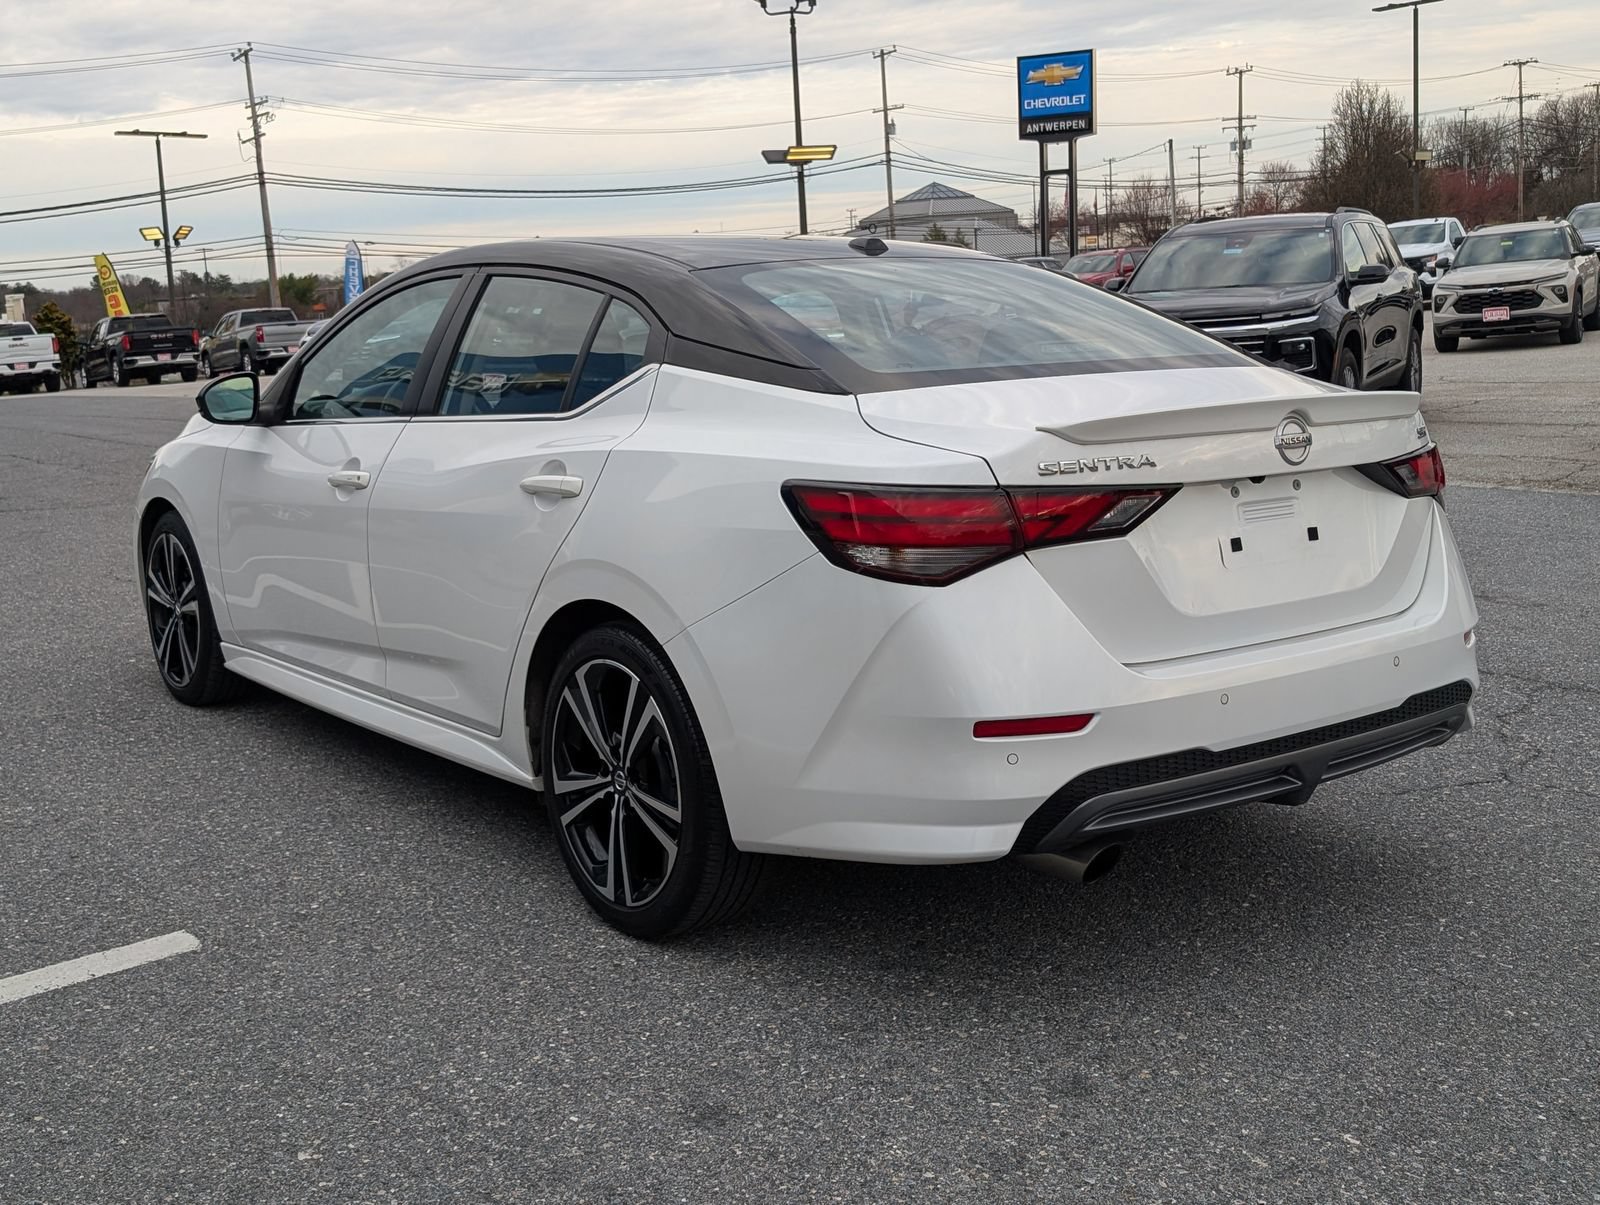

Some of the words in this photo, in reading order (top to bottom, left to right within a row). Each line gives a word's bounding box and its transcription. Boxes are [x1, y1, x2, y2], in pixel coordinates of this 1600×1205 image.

[1024, 94, 1086, 110] CHEVROLET
[1026, 120, 1085, 133] ANTWERPEN
[1281, 435, 1311, 446] NISSAN
[1038, 454, 1157, 476] SENTRA
